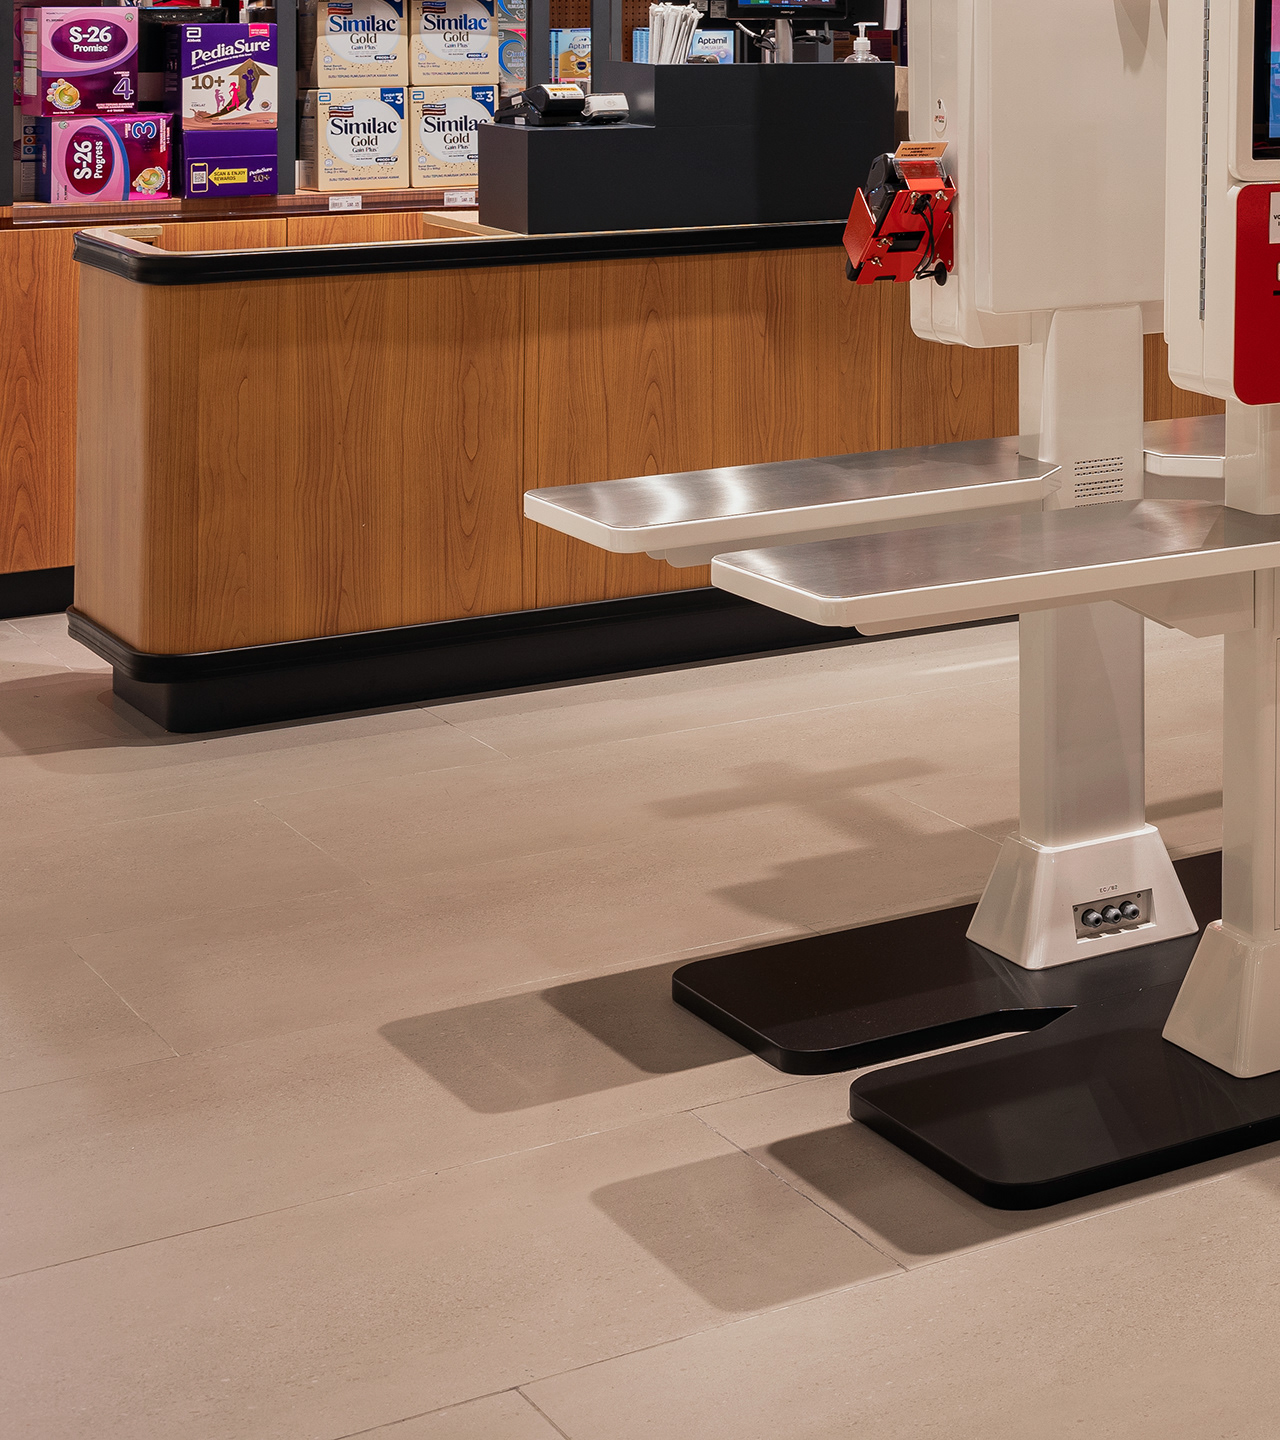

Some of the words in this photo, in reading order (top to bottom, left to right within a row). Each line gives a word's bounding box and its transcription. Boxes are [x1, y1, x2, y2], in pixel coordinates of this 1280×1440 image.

[329, 15, 395, 32] Similac
[423, 14, 487, 31] Similac
[350, 33, 377, 44] Gold
[443, 31, 469, 42] Gold
[698, 37, 727, 45] Aptamil
[74, 44, 108, 52] Promise
[191, 38, 270, 65] PediaSure
[113, 77, 134, 100] 4
[191, 74, 225, 90] 10+
[132, 121, 156, 139] 3
[94, 141, 106, 179] Progress
